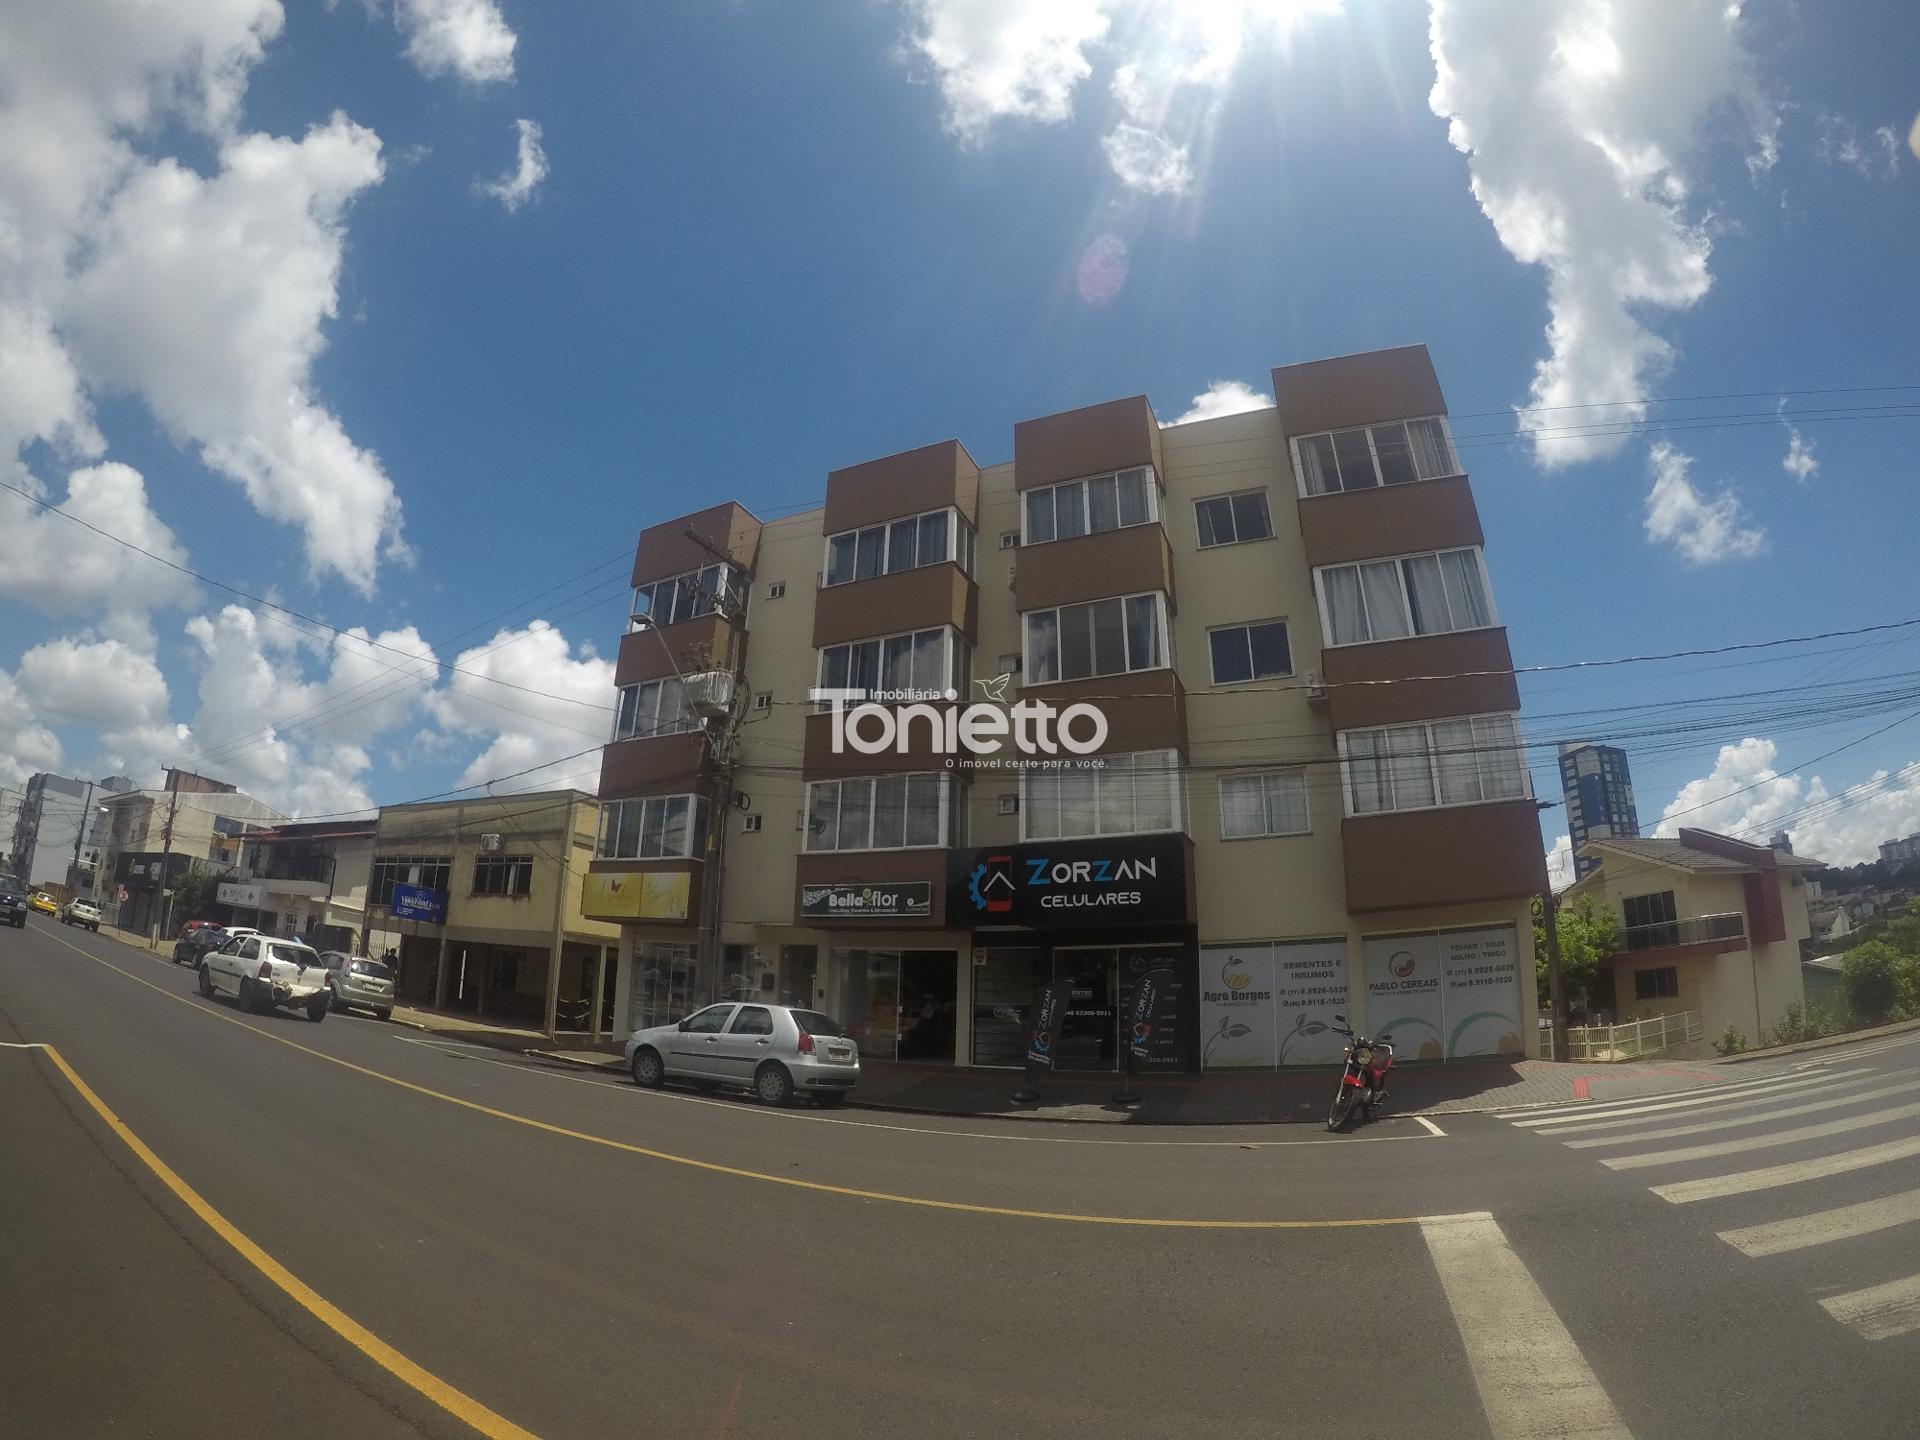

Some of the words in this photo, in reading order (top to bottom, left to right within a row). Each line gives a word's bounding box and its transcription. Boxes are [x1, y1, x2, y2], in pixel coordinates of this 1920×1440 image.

[1026, 857, 1157, 885] ZORZAN
[828, 893, 864, 907] Bella
[872, 891, 899, 907] flor
[1040, 891, 1142, 908] CELULARES
[1283, 960, 1333, 969] SEMENTES
[1335, 959, 1343, 967] E
[1291, 970, 1335, 979] INSUMOS
[1369, 981, 1398, 991] PABLO
[1400, 978, 1439, 989] CEREAIS
[1203, 991, 1229, 1002] Agro
[1231, 990, 1271, 1001] Borges
